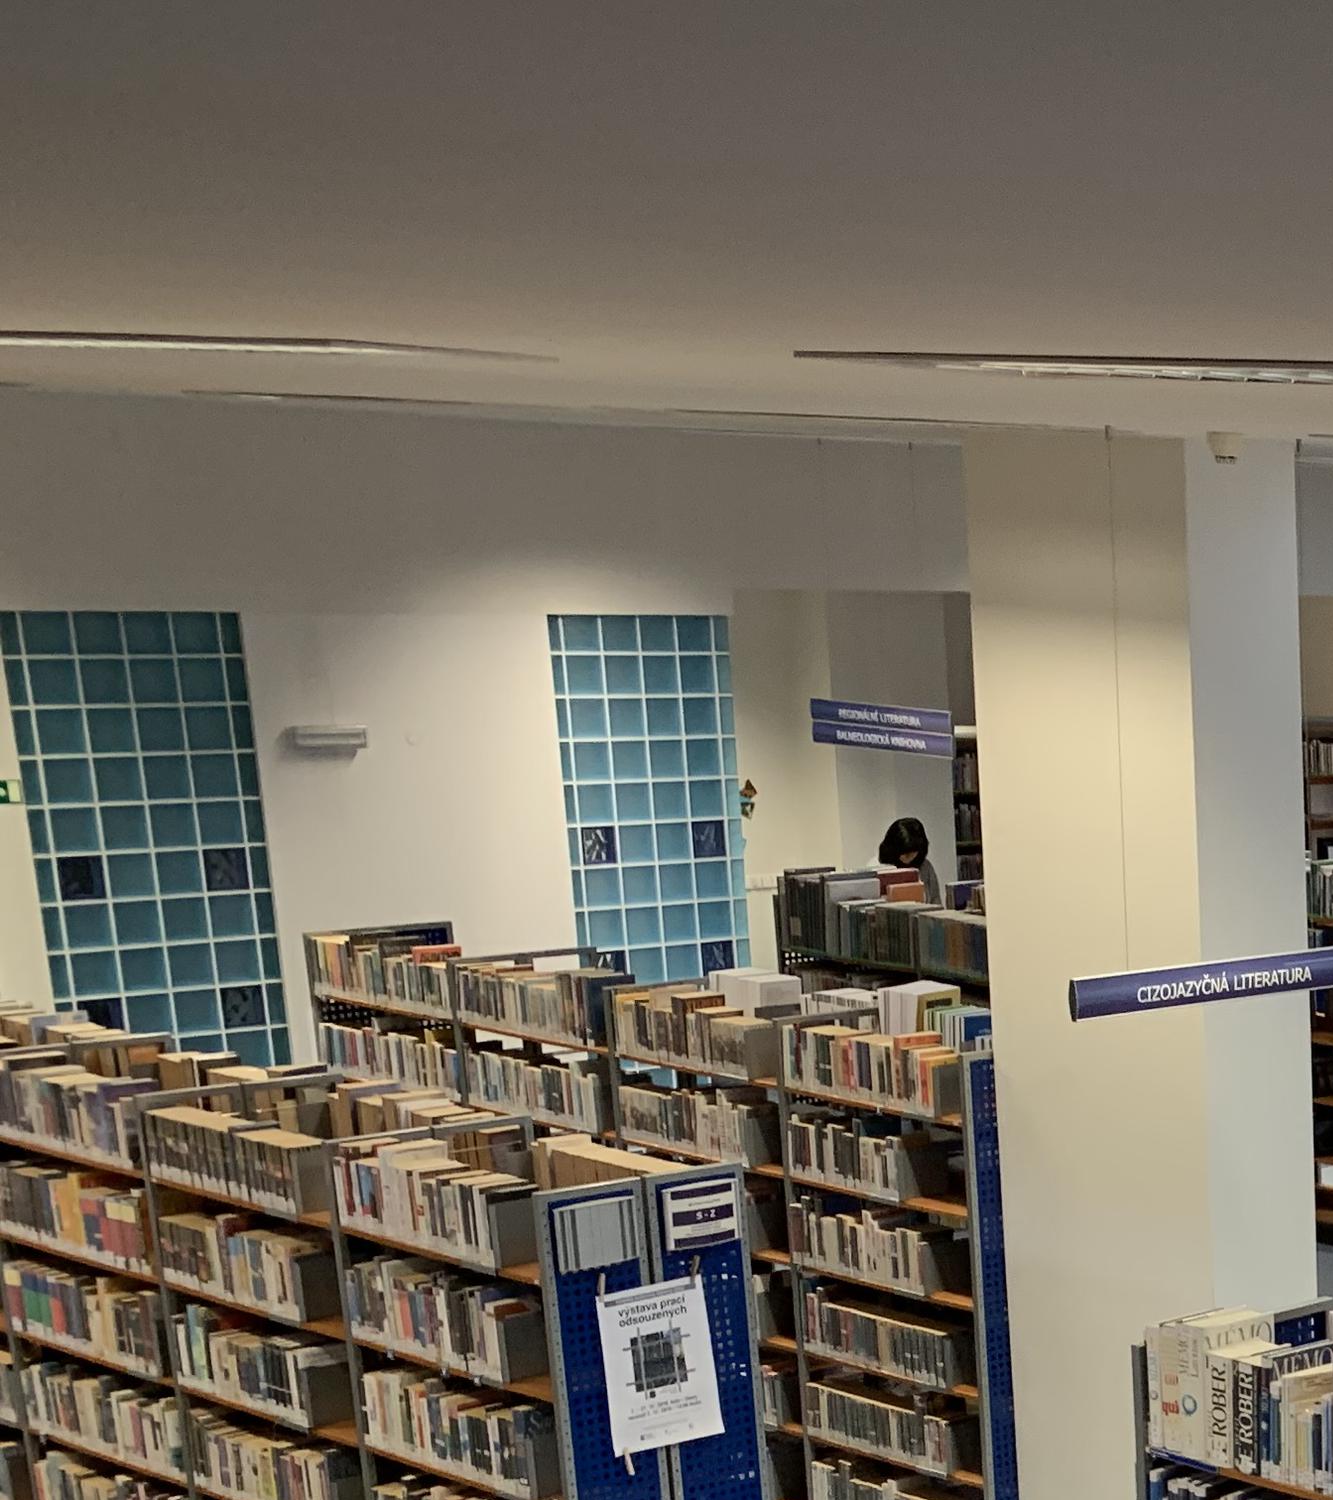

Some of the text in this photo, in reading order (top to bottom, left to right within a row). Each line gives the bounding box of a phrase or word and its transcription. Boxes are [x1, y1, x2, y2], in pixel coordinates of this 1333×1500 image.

[1137, 966, 1313, 1005] CIZOJAZYČNÁ LITERATURA
[618, 1295, 686, 1318] výstava prací
[618, 1305, 688, 1328] odsouzených
